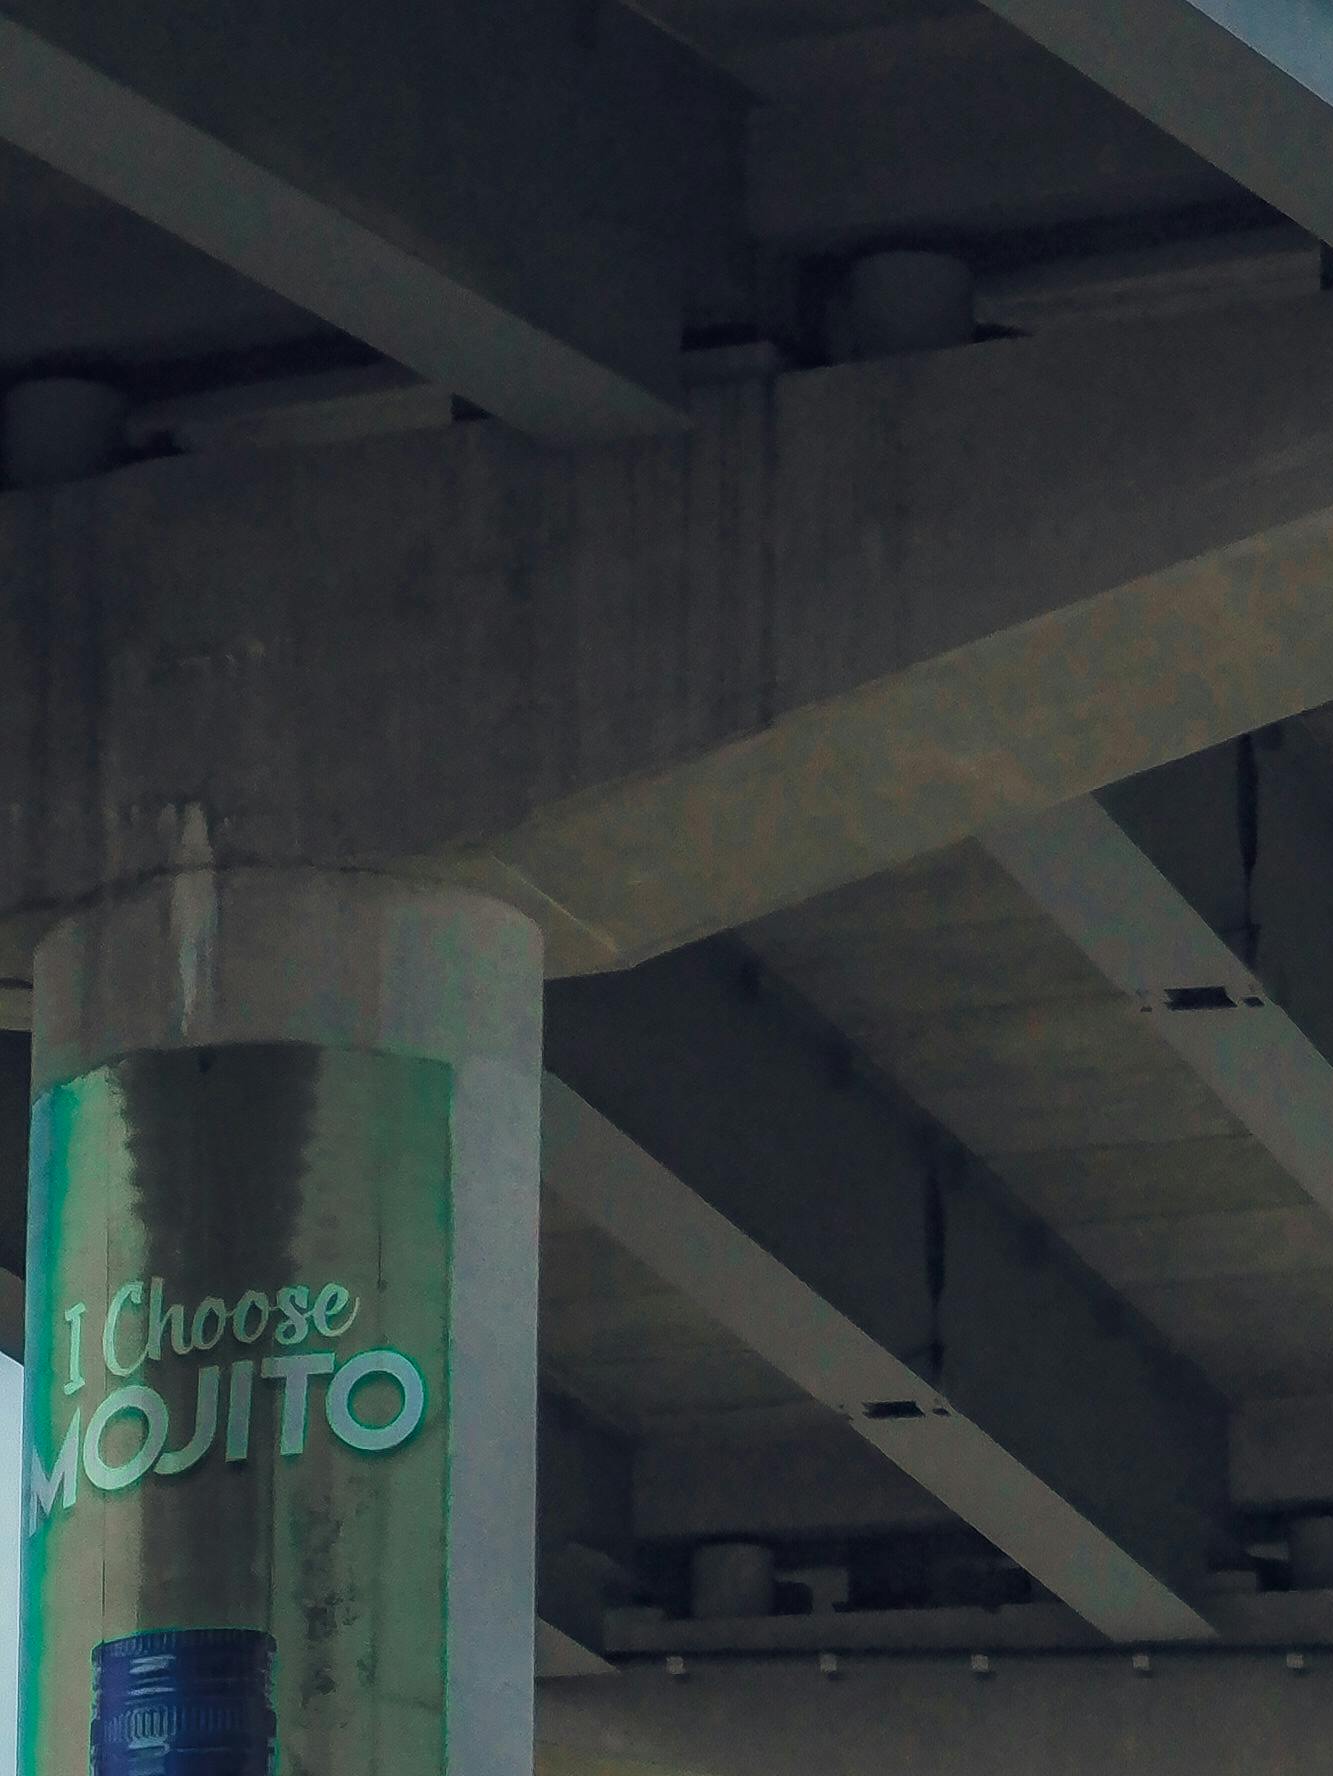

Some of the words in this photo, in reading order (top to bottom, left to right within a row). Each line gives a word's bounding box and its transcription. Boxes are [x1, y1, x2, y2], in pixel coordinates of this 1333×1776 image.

[63, 1302, 87, 1396] I
[102, 1276, 360, 1378] Choose
[27, 1349, 425, 1540] MOJITO
